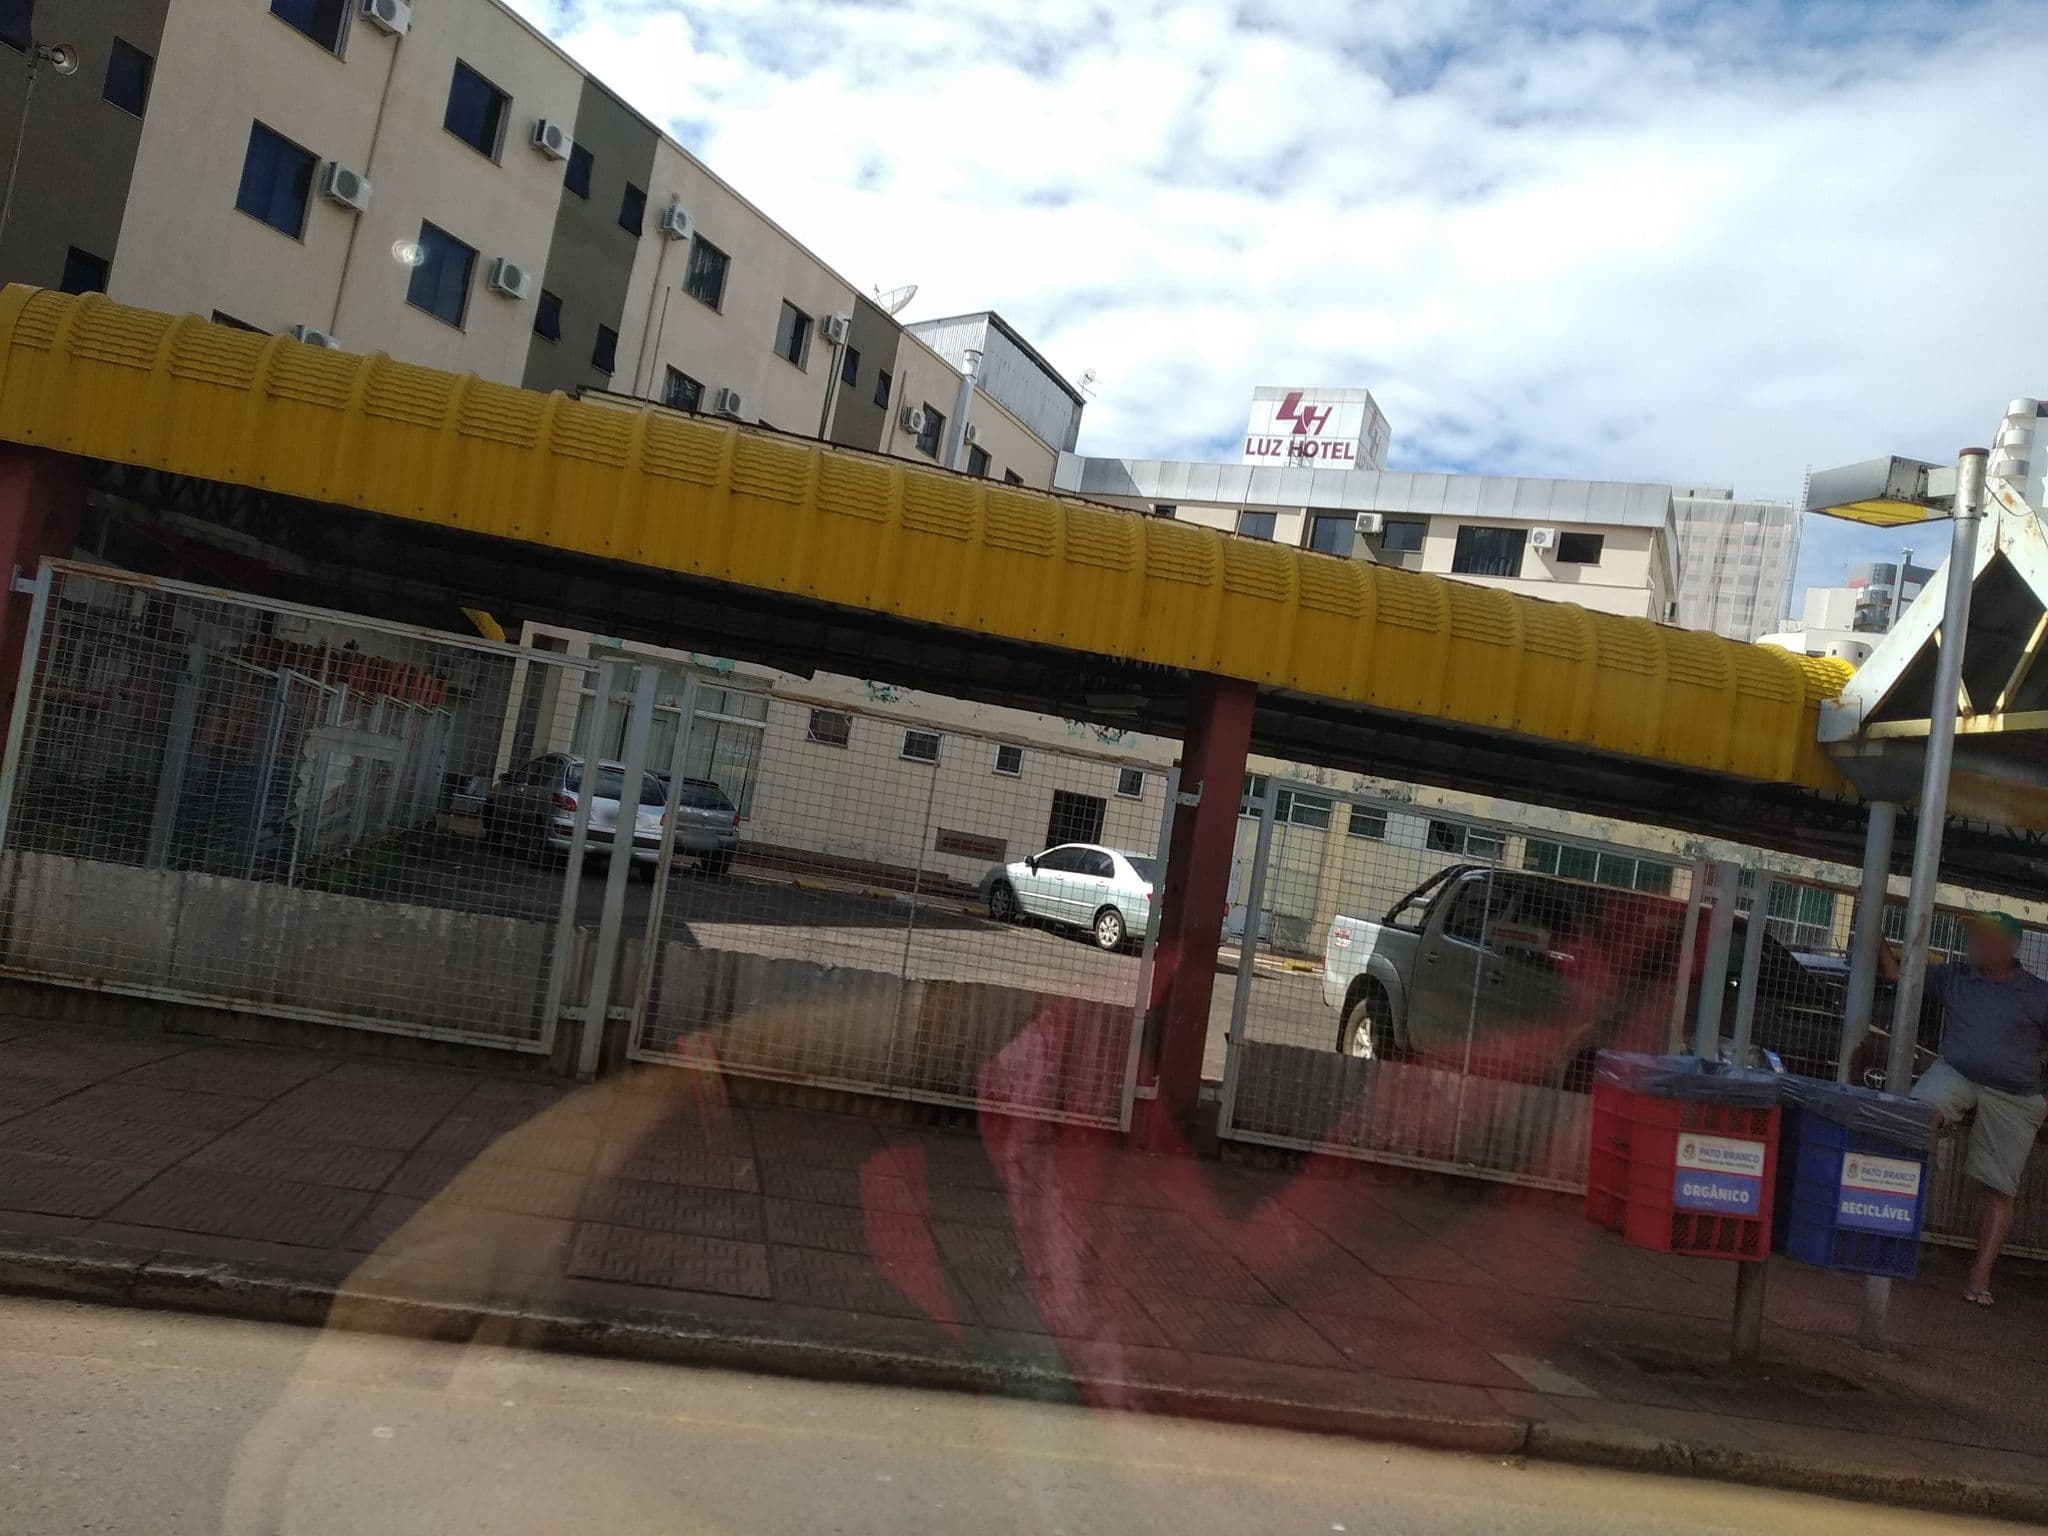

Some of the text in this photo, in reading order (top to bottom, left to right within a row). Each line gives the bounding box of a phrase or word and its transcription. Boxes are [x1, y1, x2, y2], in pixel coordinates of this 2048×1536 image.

[1245, 438, 1283, 457] LUZ
[1287, 440, 1355, 460] HOTEL
[1722, 1150, 1760, 1163] BRANCO
[1682, 1184, 1750, 1203] ORGÂNICO
[1841, 1201, 1911, 1221] RECICLÁVEL
